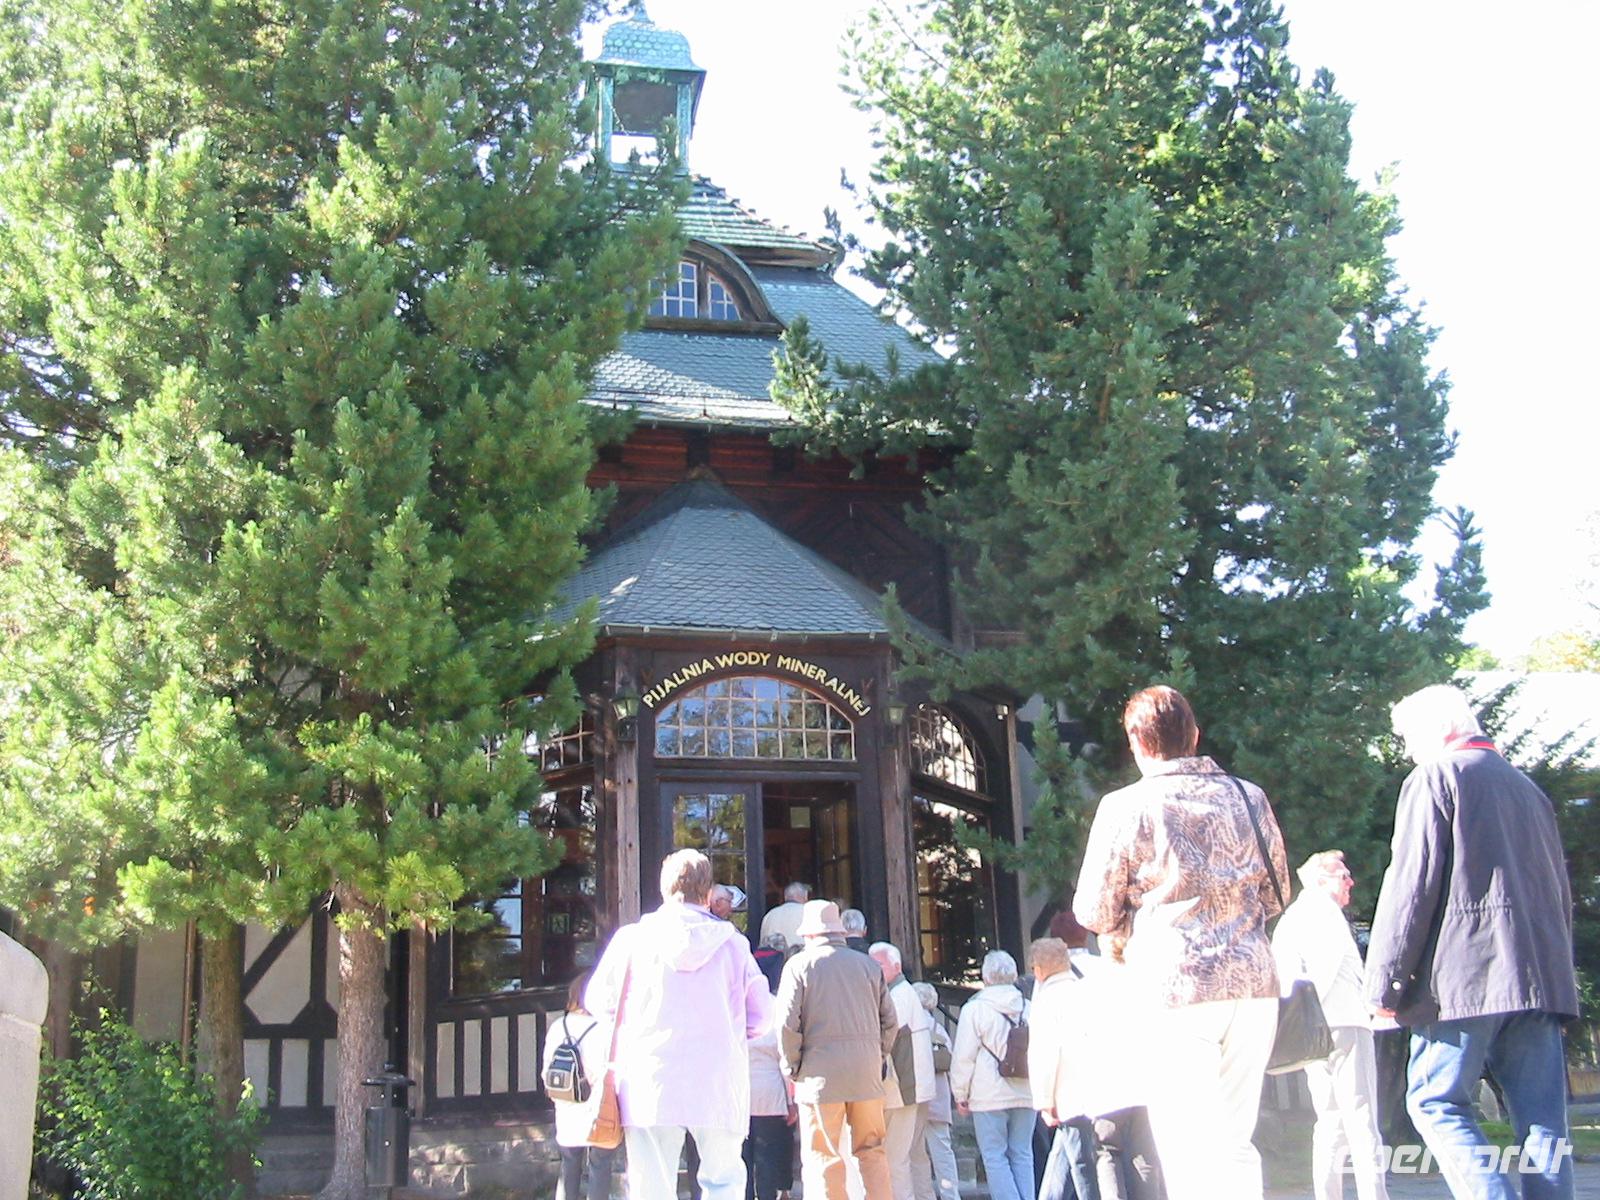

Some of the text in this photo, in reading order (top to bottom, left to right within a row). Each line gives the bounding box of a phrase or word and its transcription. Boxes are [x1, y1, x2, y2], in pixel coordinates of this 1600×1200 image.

[642, 651, 872, 717] PIJALNIA WODY MINERALNEJ
